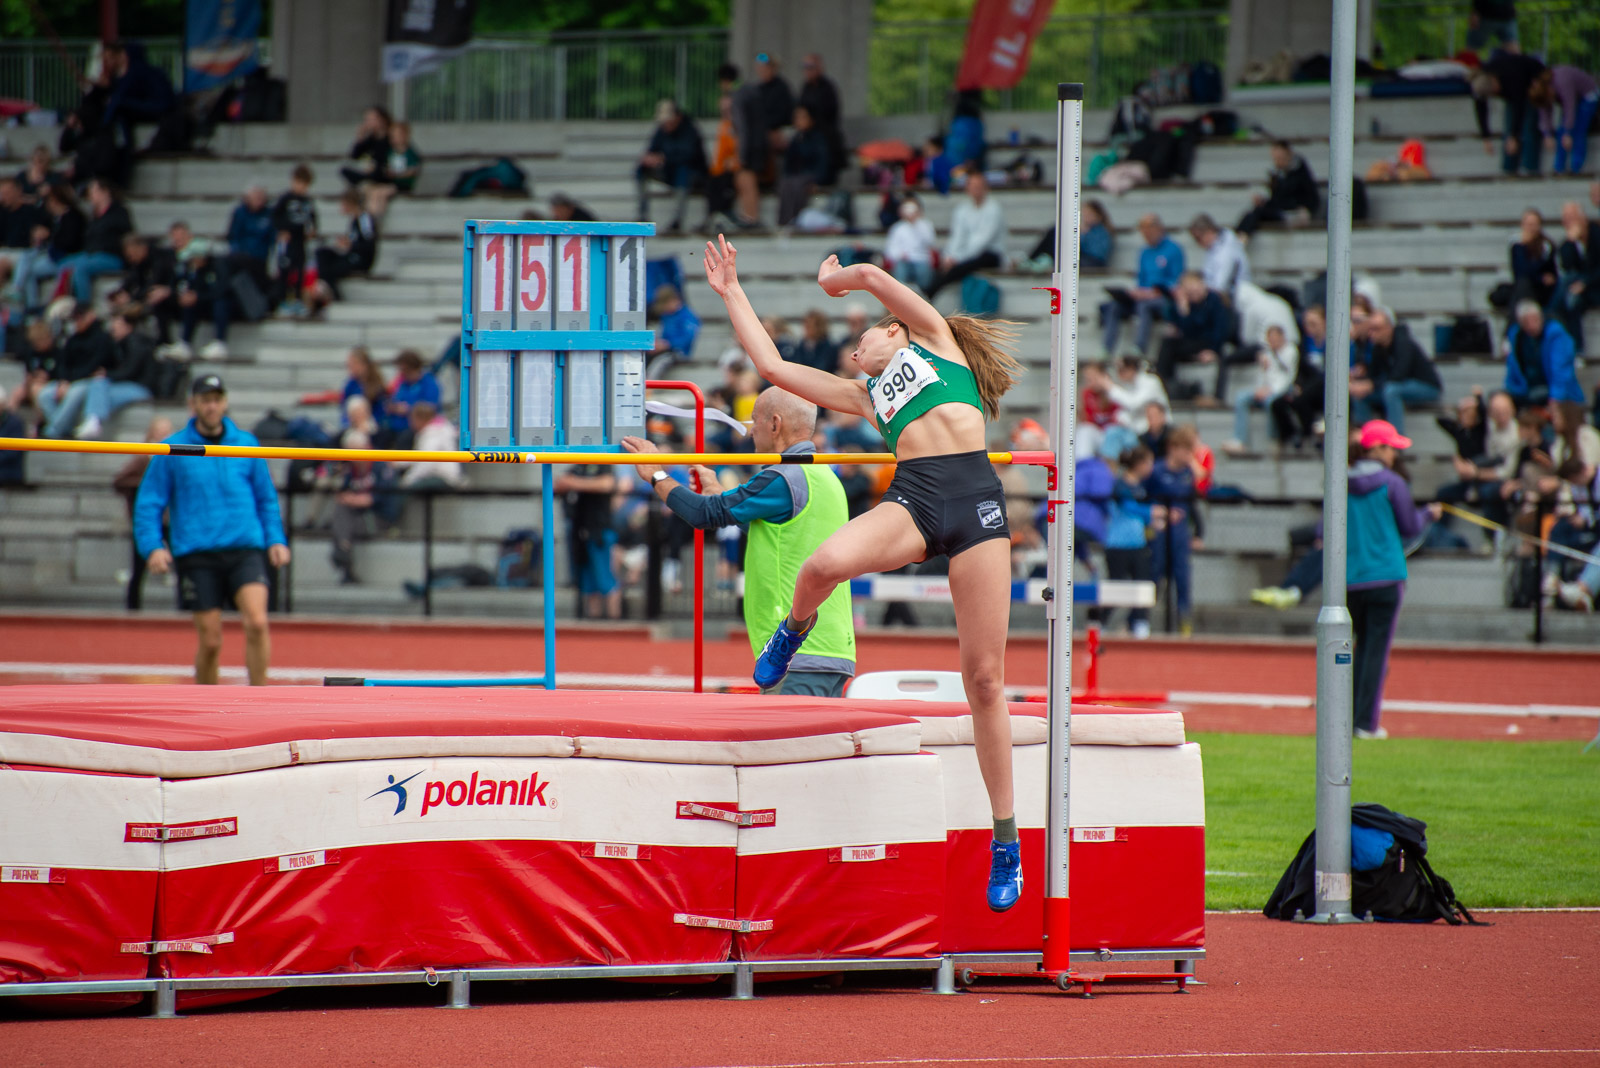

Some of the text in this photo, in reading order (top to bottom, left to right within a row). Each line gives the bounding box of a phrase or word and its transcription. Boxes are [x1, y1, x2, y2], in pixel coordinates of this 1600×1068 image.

[882, 362, 917, 402] 990
[984, 512, 999, 523] SIL
[420, 770, 550, 817] polanik
[169, 828, 195, 838] POLANIK
[1083, 830, 1106, 840] POLANIK
[604, 845, 628, 857] POLANIK
[852, 848, 876, 860] POLANIK
[289, 854, 316, 868] POLANIK
[11, 869, 40, 881] POLANIK
[166, 942, 193, 952] POLANIK
